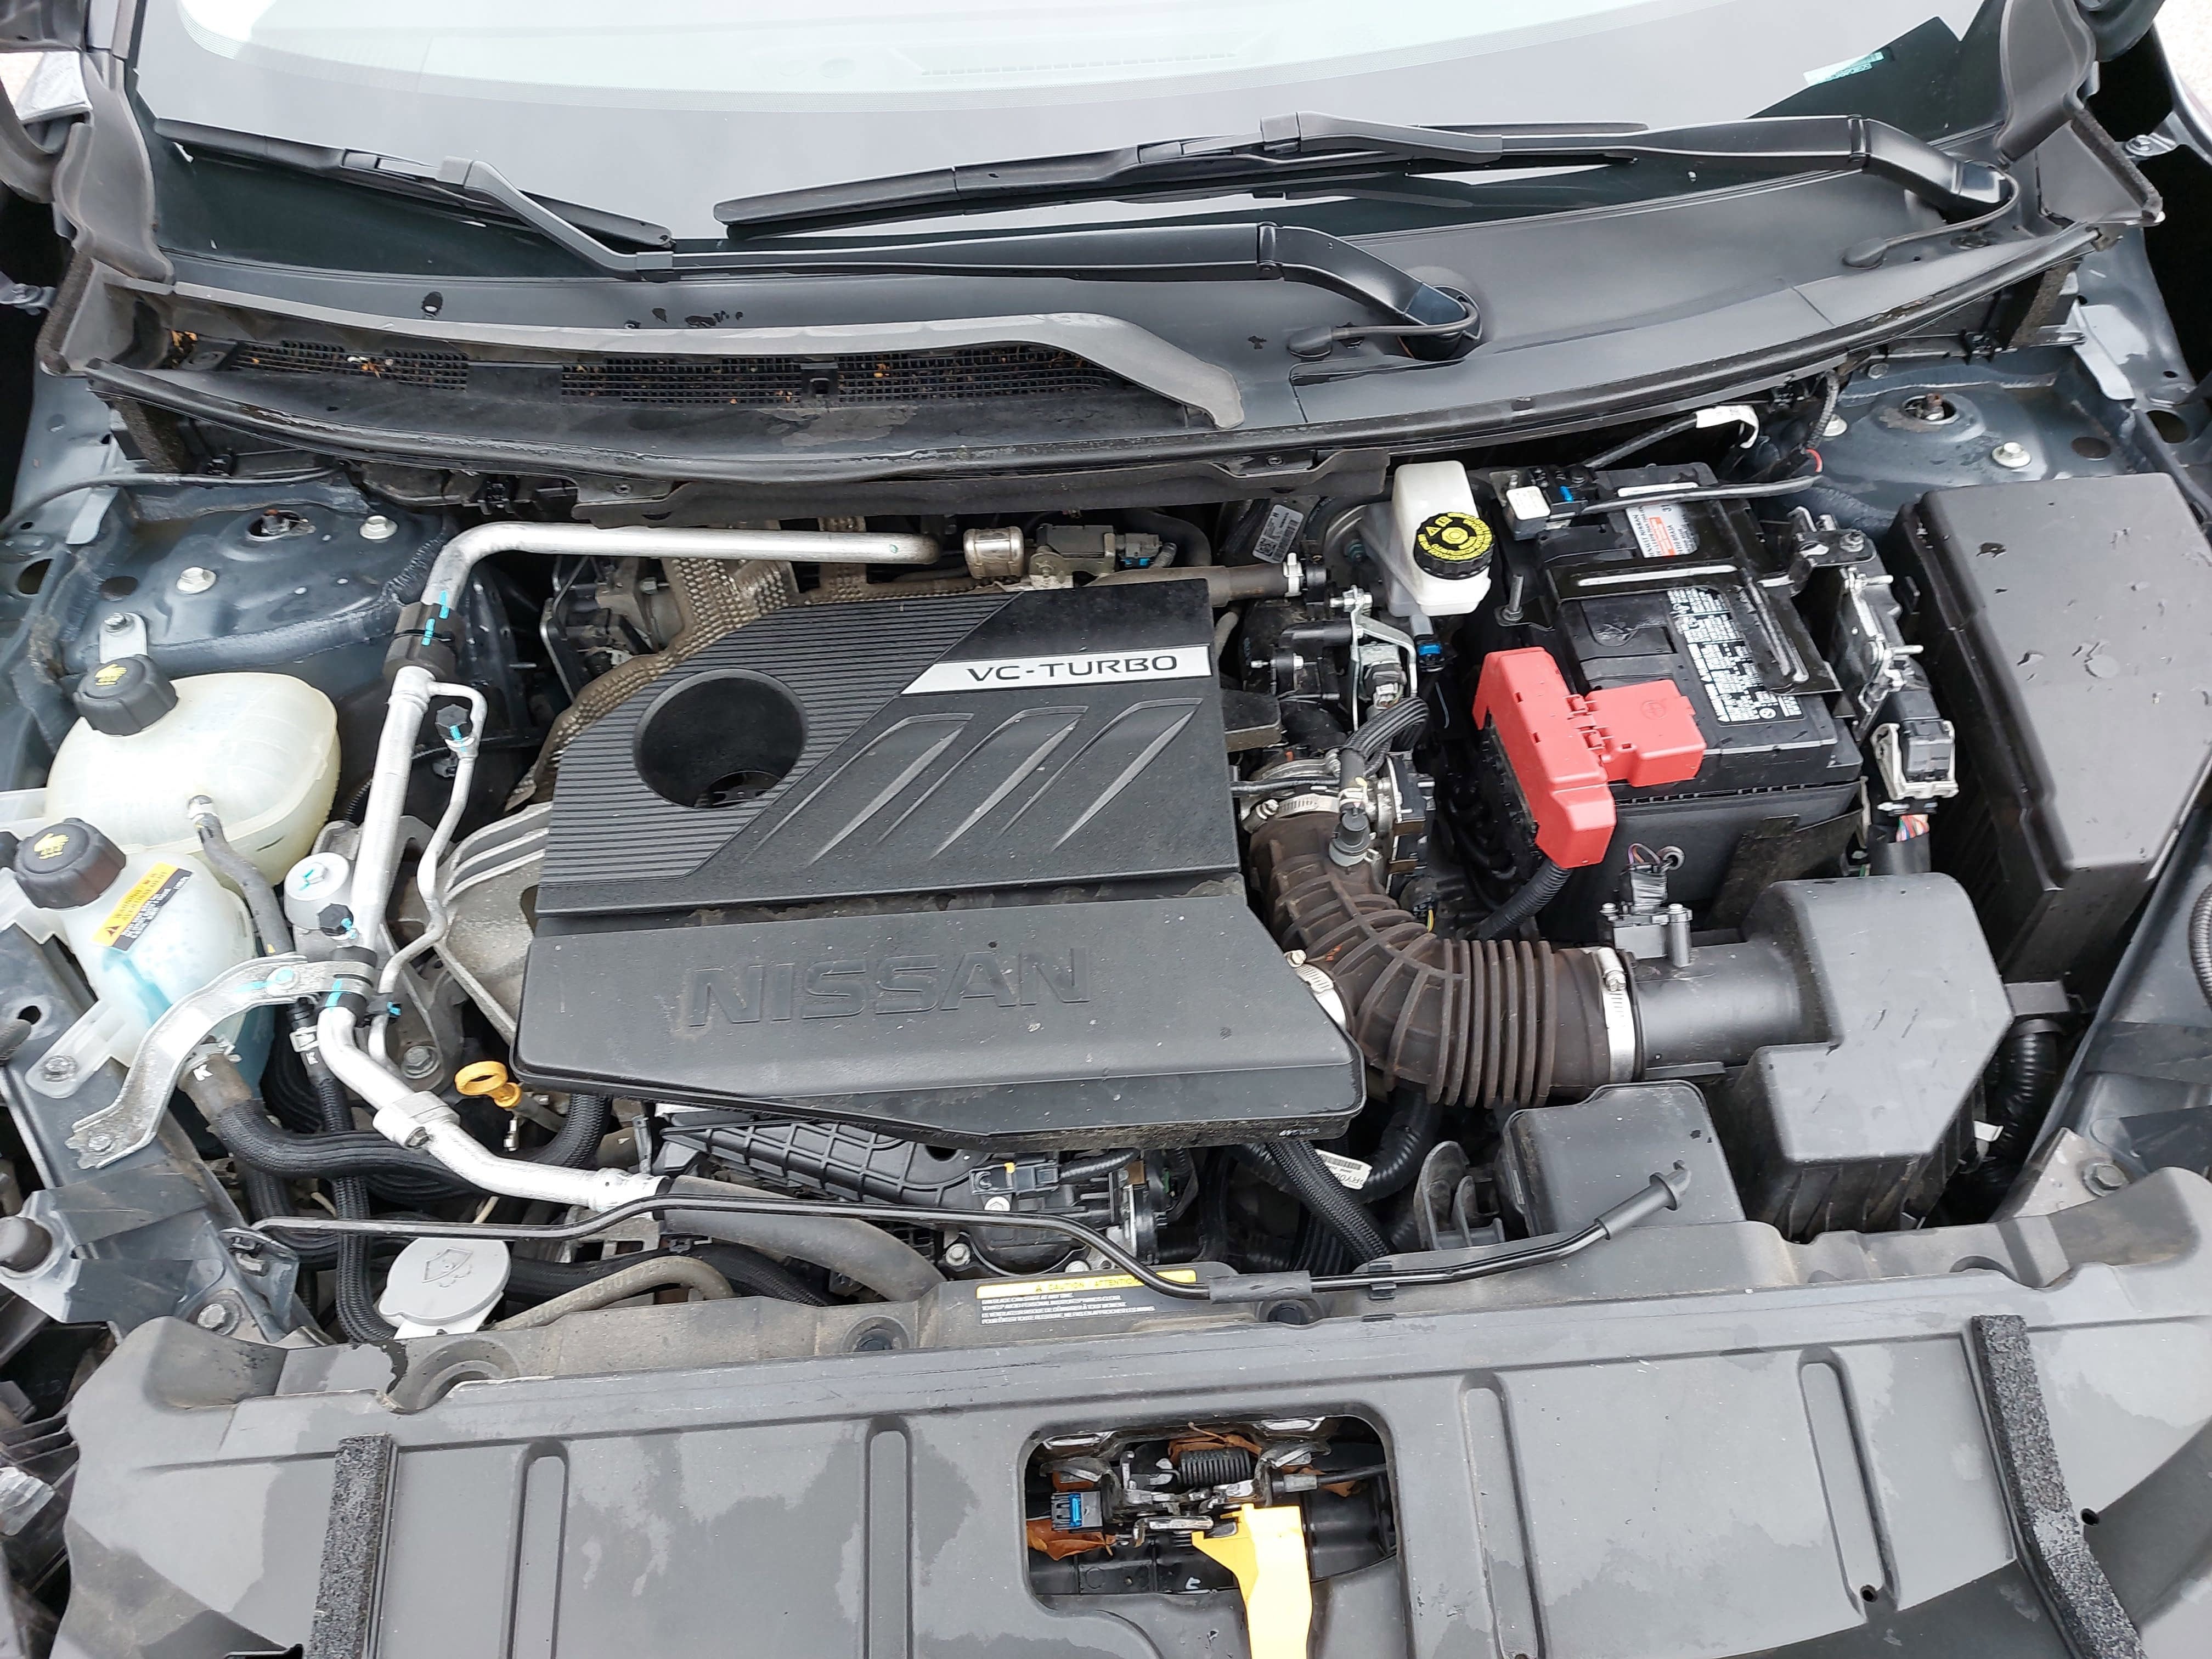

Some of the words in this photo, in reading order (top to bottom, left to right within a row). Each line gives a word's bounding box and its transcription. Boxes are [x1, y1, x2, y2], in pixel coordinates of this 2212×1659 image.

[966, 656, 1177, 682] VC-TURBO
[687, 947, 1091, 1028] NISSAN
[1048, 1281, 1085, 1291] CAUTION
